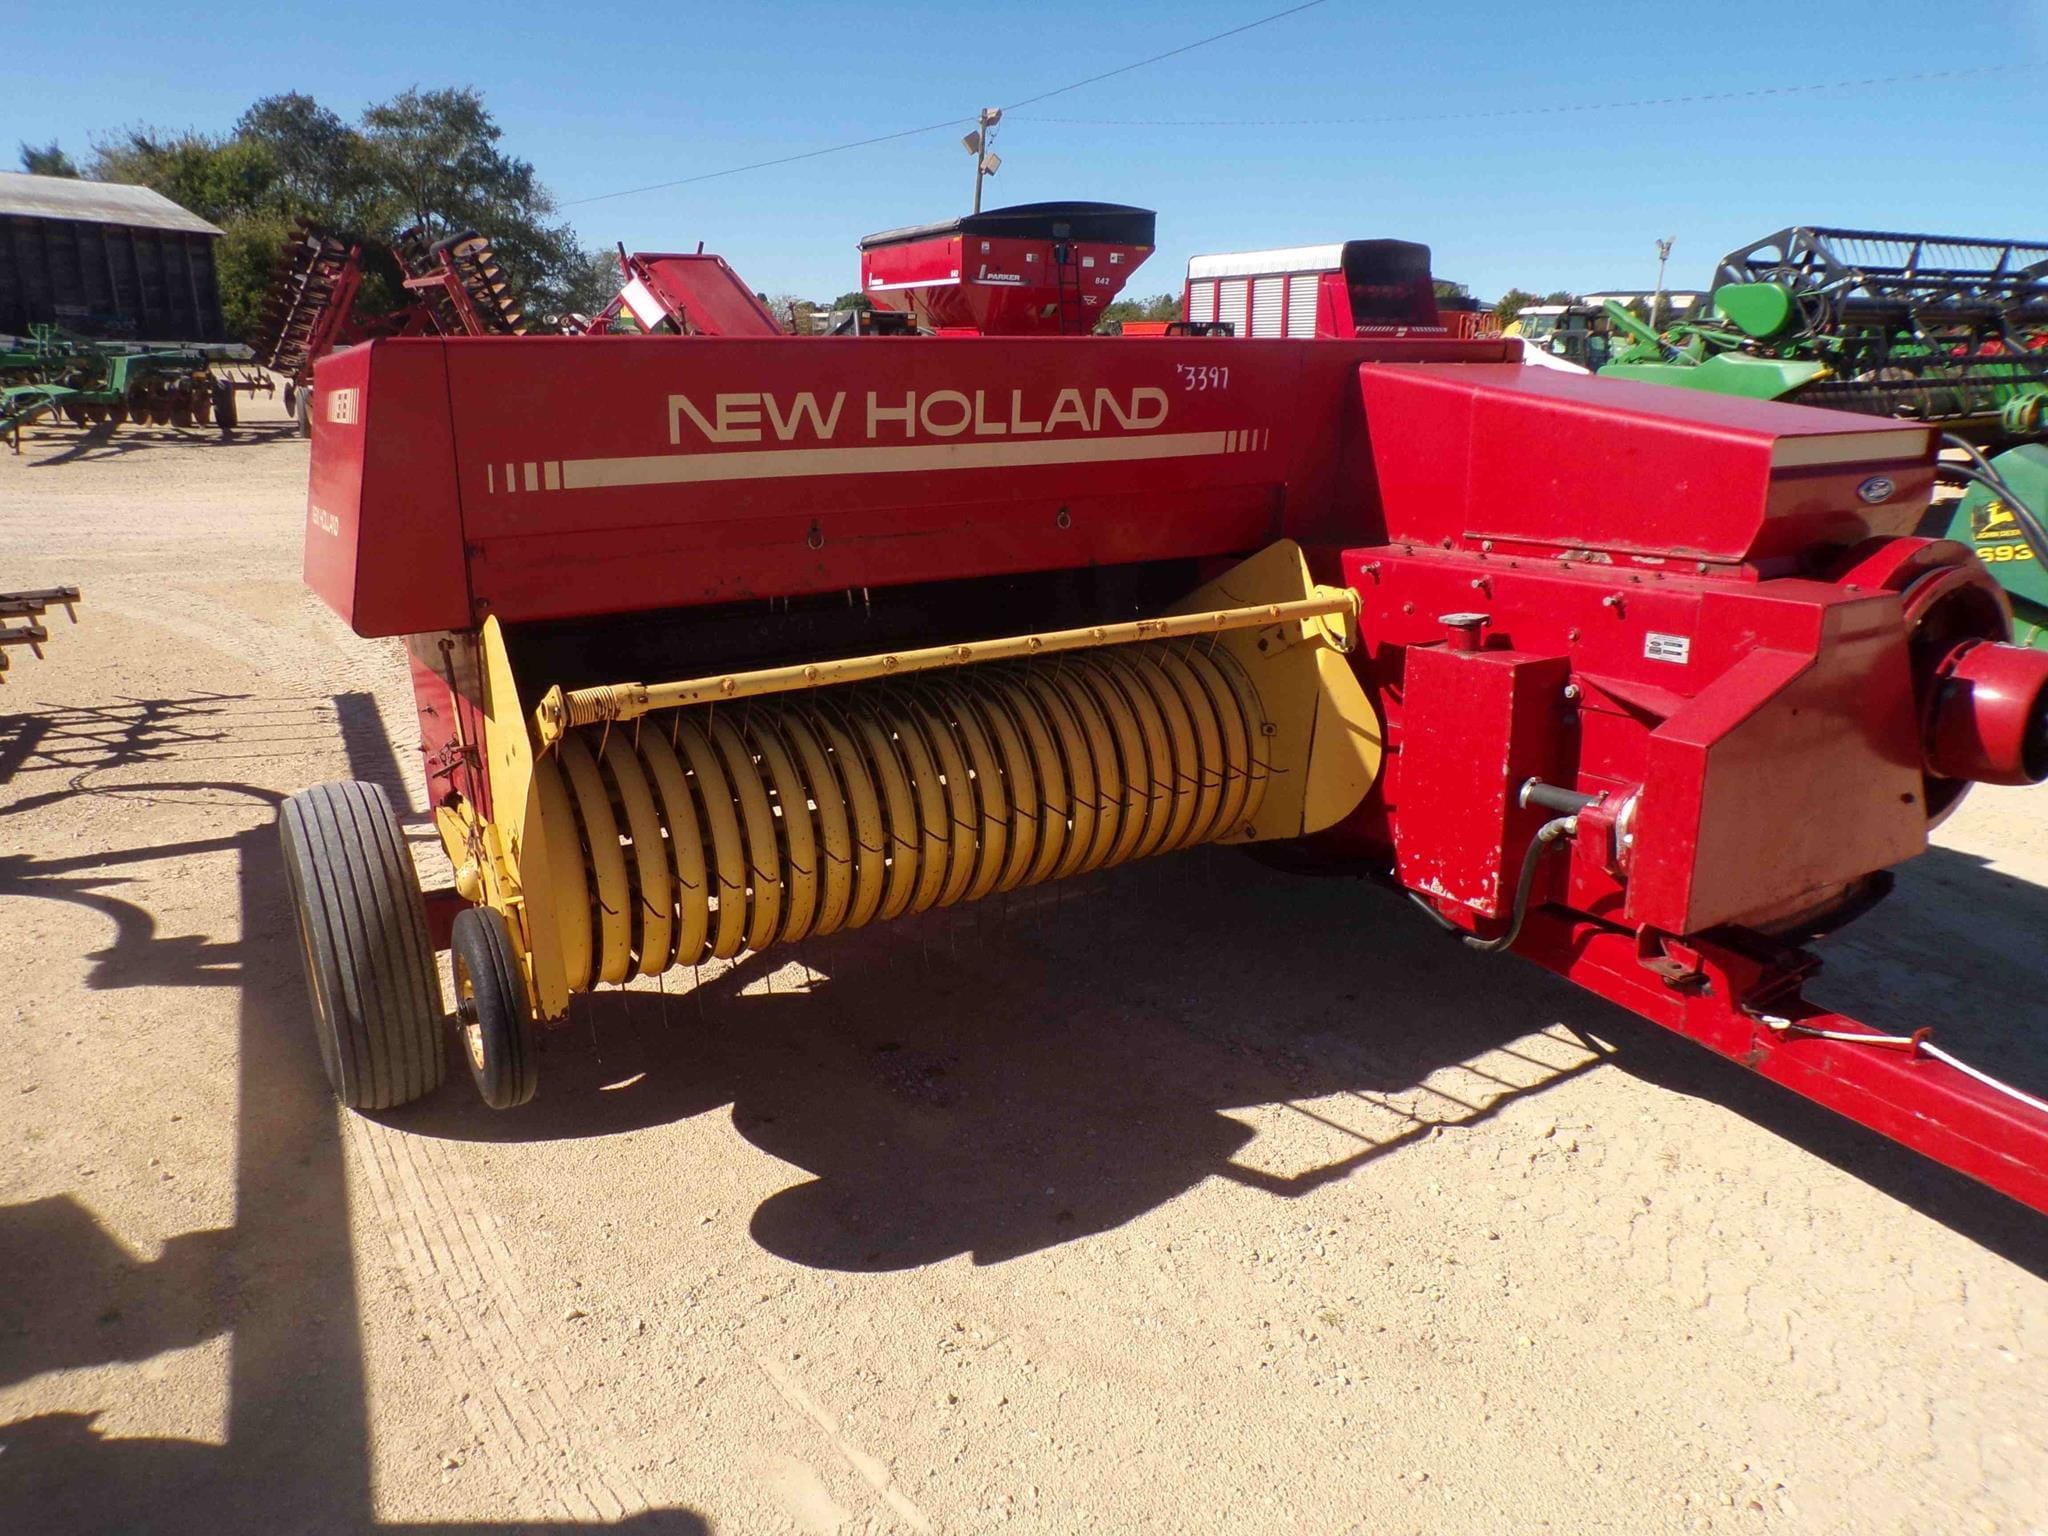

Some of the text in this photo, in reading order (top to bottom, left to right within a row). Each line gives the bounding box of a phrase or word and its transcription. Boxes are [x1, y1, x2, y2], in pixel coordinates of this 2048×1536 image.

[987, 273, 1021, 281] PARKER
[668, 387, 1169, 445] NEW HOLLAND
